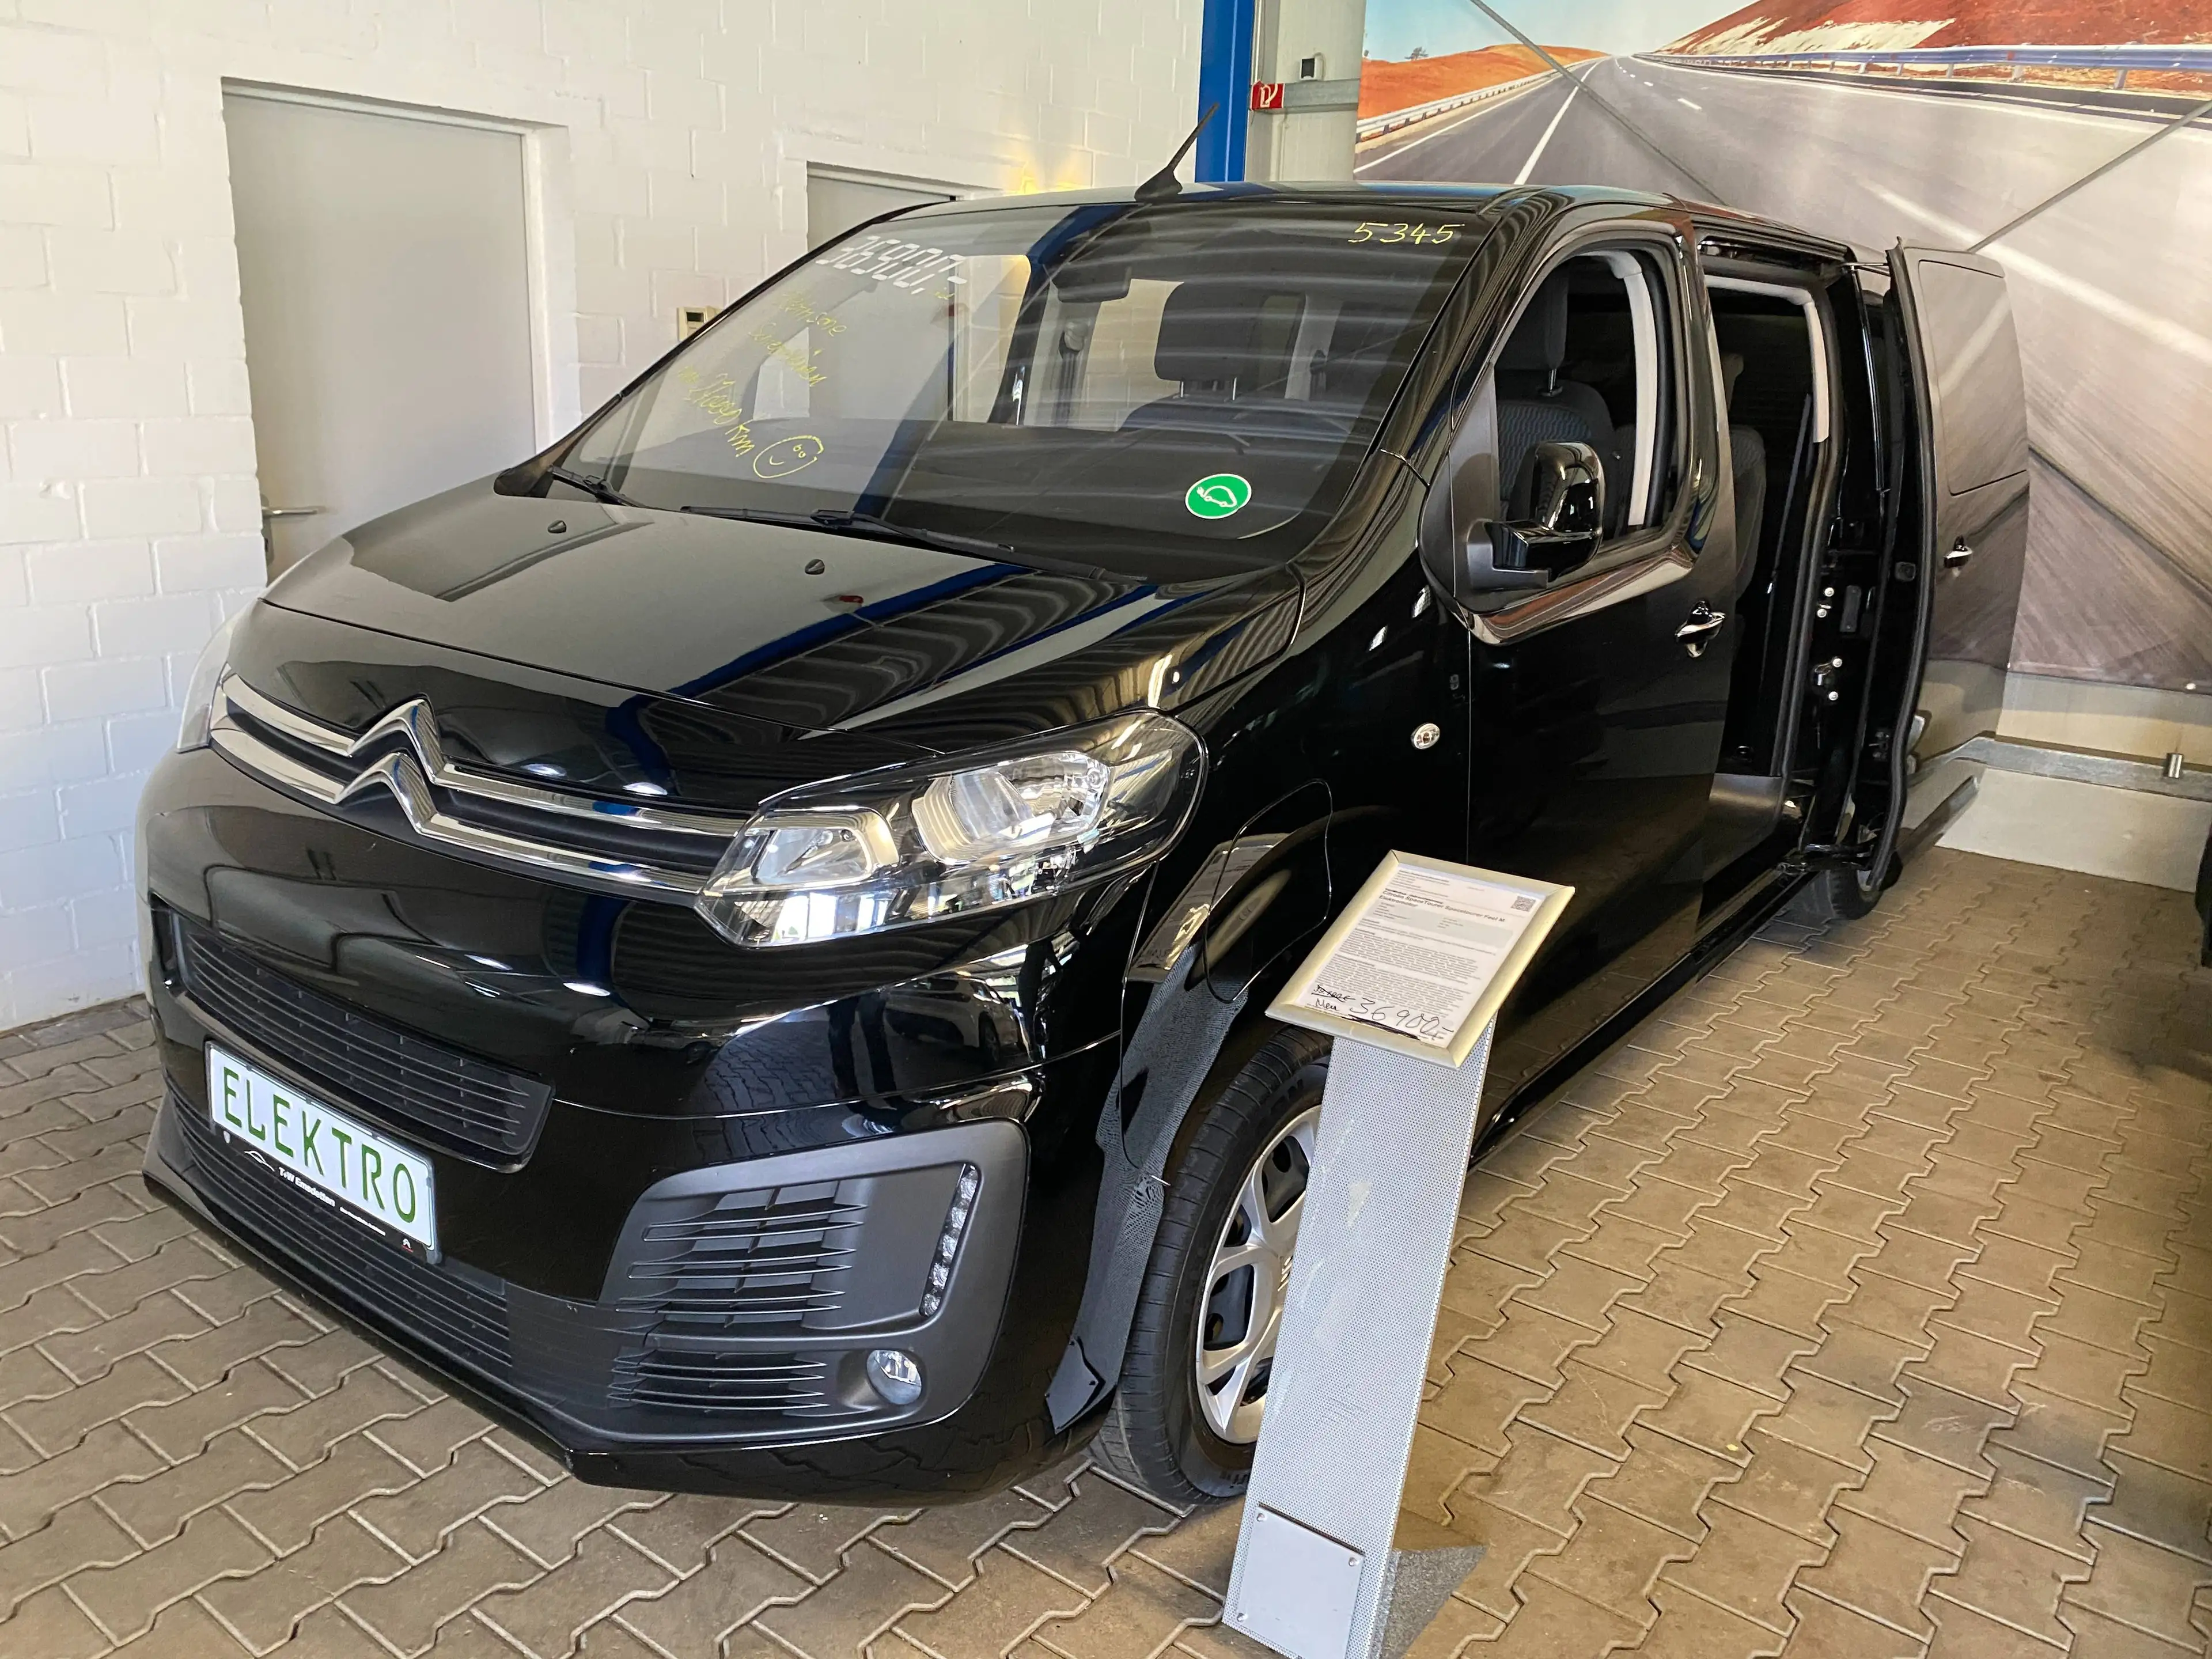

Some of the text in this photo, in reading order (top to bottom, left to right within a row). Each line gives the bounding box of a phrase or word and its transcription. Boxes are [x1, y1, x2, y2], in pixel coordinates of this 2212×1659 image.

[1348, 222, 1465, 244] 5345
[1315, 998, 1339, 1011] Neu
[224, 1067, 416, 1223] ELEKTRO
